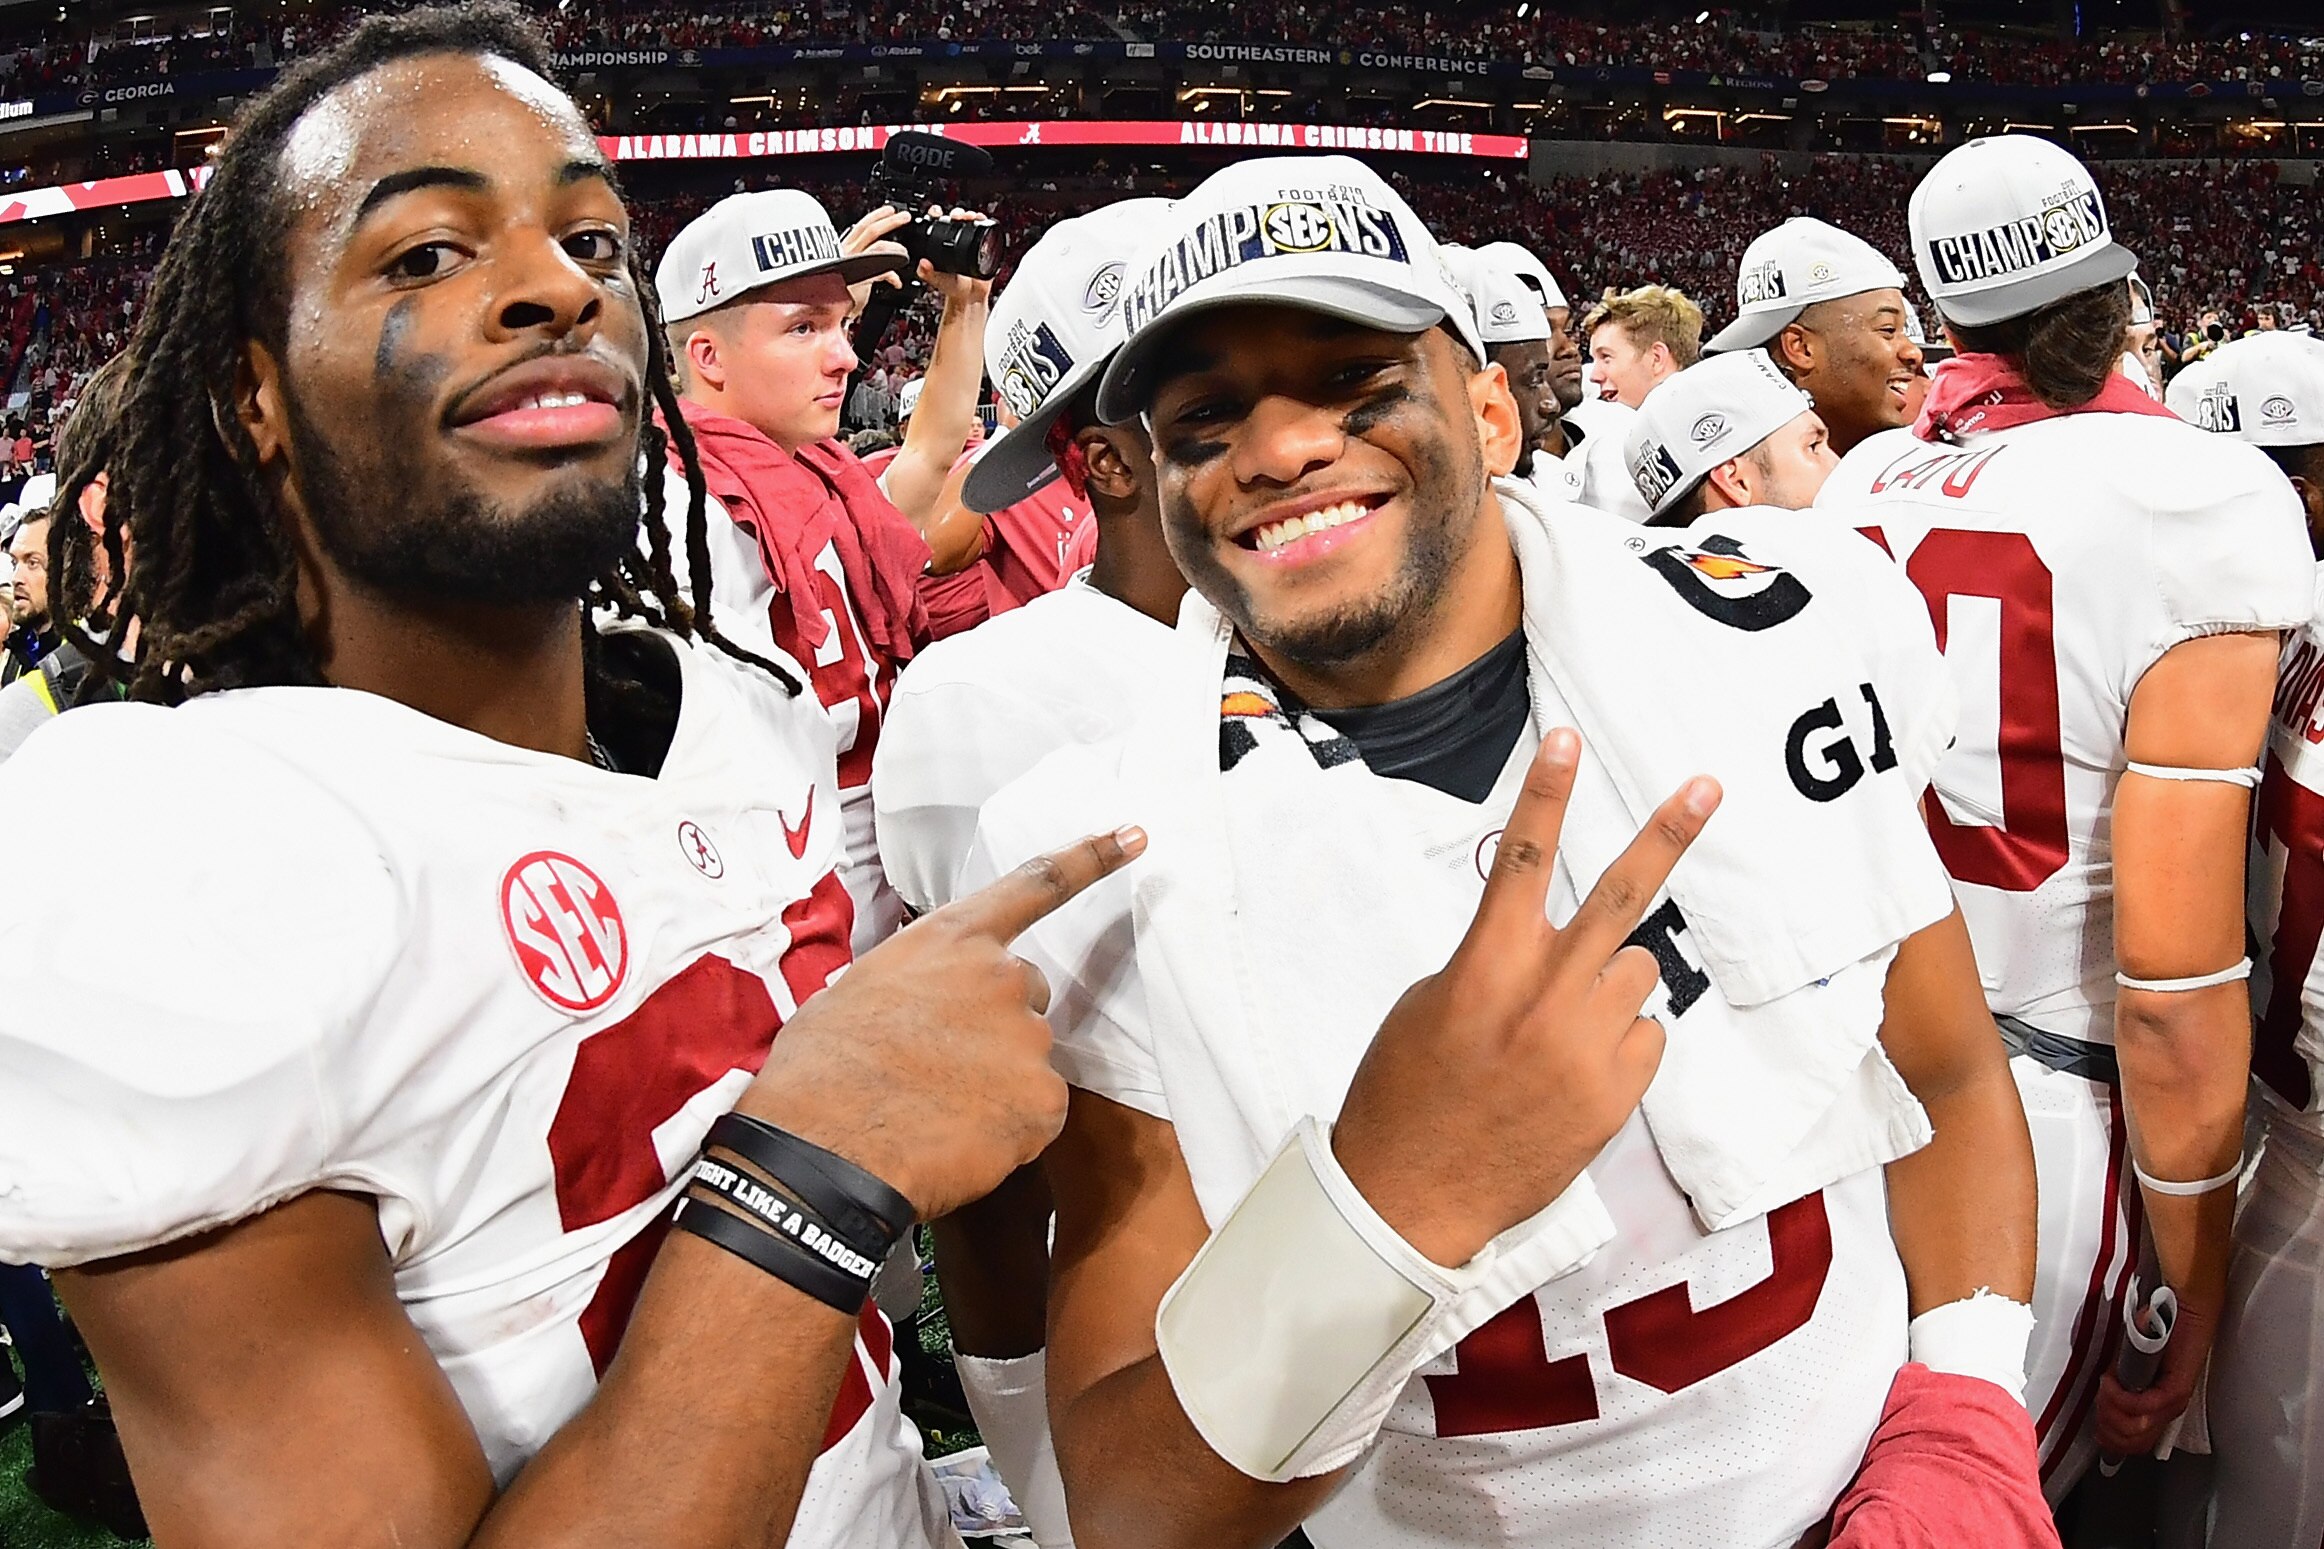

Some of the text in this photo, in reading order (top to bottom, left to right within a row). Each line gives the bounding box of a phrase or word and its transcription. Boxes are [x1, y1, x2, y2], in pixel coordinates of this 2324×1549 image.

[549, 51, 668, 67] HAMPIONSHIP
[1186, 44, 1331, 64] SOUTHEASTERN
[1359, 52, 1489, 75] CONFERENCE
[104, 81, 175, 103] GEORGIA
[617, 134, 737, 159] ALABAMA
[748, 125, 874, 156] CRIMSON
[1180, 121, 1473, 154] ALABAMA CRIMSON TIDE
[511, 857, 622, 1004] SEC
[732, 1178, 788, 1224] LIKE
[781, 1211, 804, 1237] A
[800, 1222, 876, 1280] BADGER
